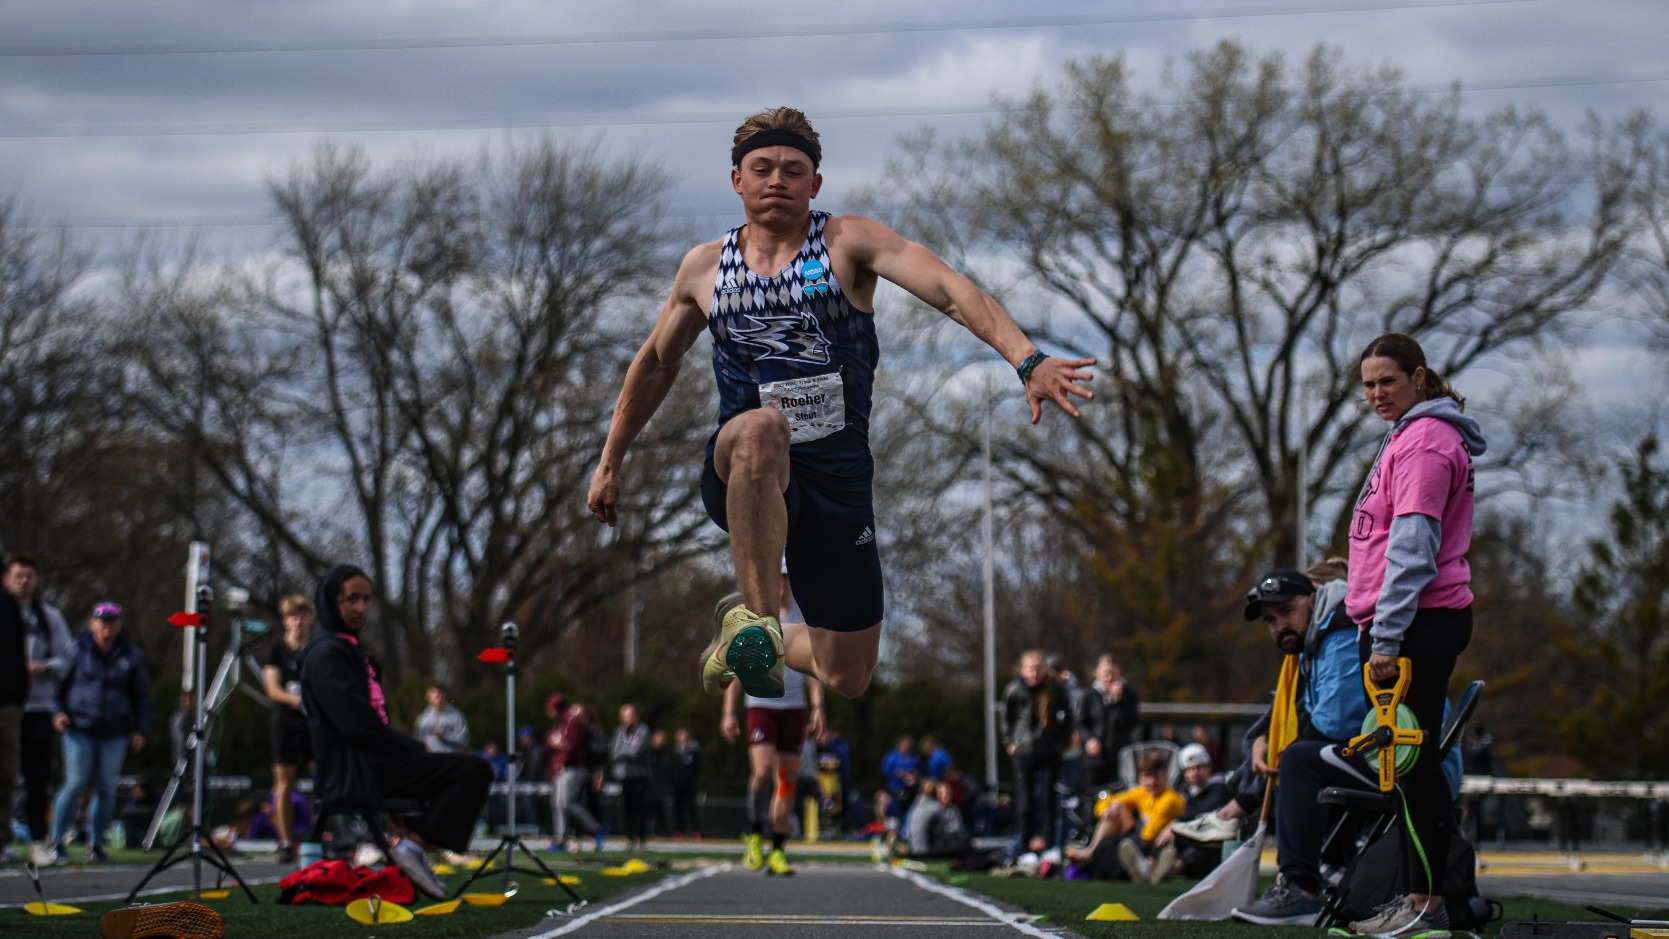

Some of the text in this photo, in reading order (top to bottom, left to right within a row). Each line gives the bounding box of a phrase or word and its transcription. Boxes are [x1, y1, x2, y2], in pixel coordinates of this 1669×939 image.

[805, 267, 823, 276] NCAA
[720, 287, 741, 295] adidas
[780, 393, 826, 409] Roeber
[795, 411, 818, 421] Stout
